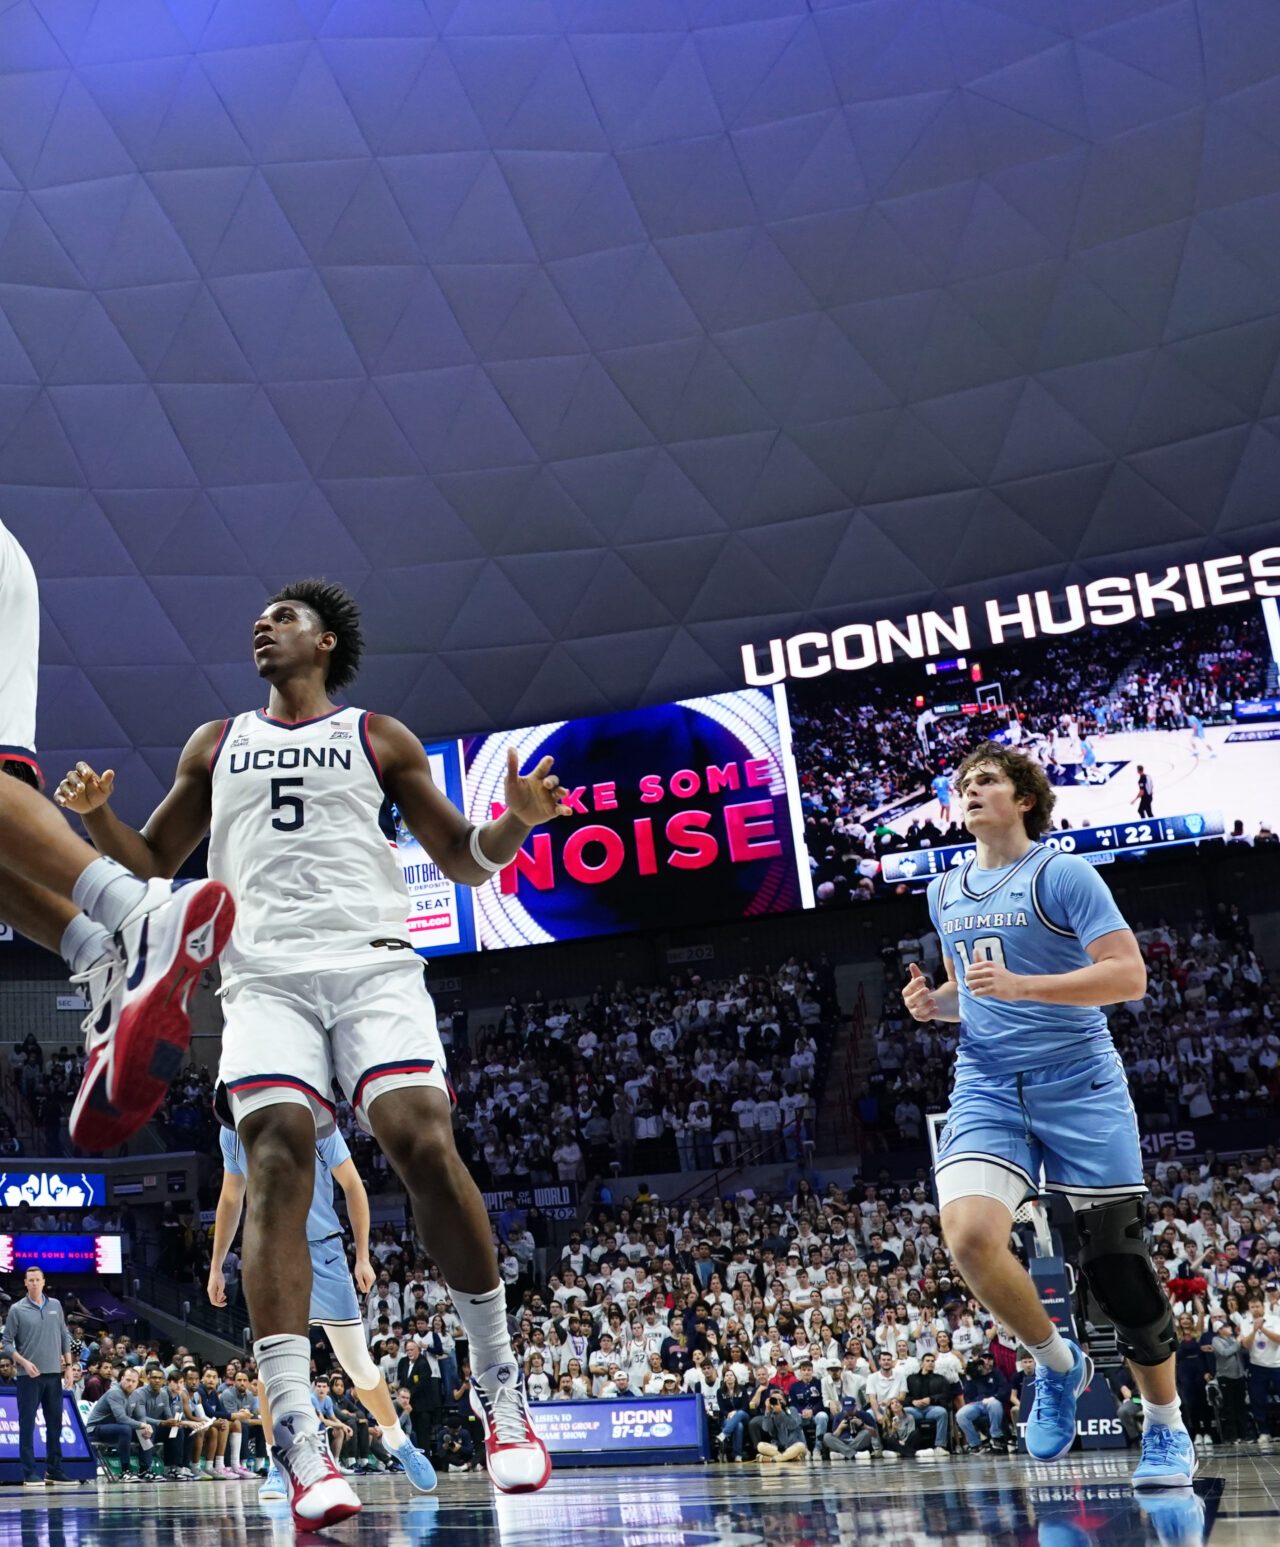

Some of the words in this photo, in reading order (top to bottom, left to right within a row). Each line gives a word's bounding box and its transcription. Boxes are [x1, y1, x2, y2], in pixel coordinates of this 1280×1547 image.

[740, 605, 971, 687] UCONN
[984, 546, 1280, 645] HUSKIES
[230, 747, 351, 774] UCONN
[639, 759, 773, 803] SOME
[270, 777, 305, 832] 5
[1125, 825, 1153, 844] 22
[500, 799, 783, 895] NOISE
[1084, 852, 1112, 864] ONUS
[414, 881, 450, 891] DEPOSITS
[416, 897, 451, 911] SEAT
[943, 912, 1028, 936] COLUMBIA
[686, 945, 714, 959] 202
[1140, 1130, 1196, 1153] KIES
[534, 1186, 570, 1207] WORLD
[550, 1423, 570, 1431] AUTO
[571, 1421, 600, 1431] GROUP
[561, 1413, 572, 1422] TO
[611, 1408, 673, 1426] UCONN
[540, 1431, 561, 1441] GAME
[612, 1425, 644, 1439] 97-9
[1016, 1418, 1123, 1438] TLERS
